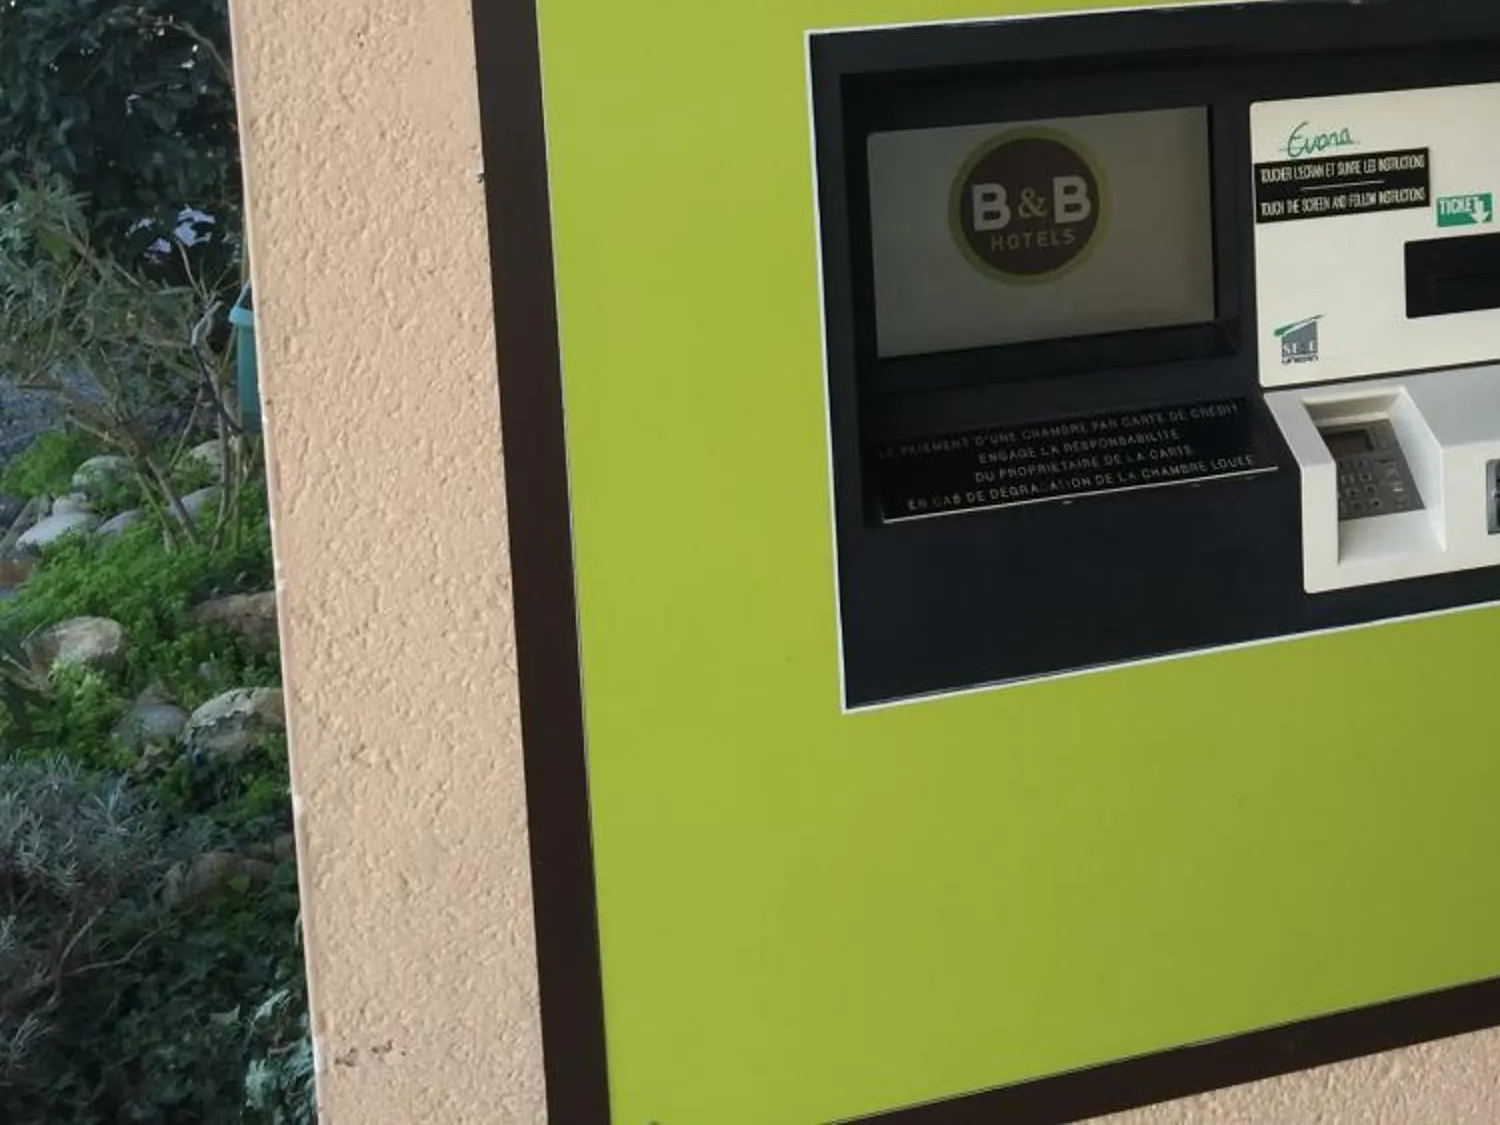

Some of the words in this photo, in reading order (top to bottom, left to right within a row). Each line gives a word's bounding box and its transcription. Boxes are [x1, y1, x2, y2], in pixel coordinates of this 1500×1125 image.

[1260, 166, 1293, 183] TOUCHER
[1326, 162, 1336, 177] ET
[1337, 159, 1363, 177] SUIVRE
[1364, 158, 1377, 174] LES
[1378, 154, 1425, 172] INSTRUCTIONS
[971, 174, 1093, 232] B&B
[1260, 200, 1285, 217] TOUCH
[1287, 199, 1301, 215] THE
[1302, 196, 1331, 213] SCREEN
[1332, 194, 1347, 211] AND
[1348, 191, 1377, 209] FOLLOW
[1378, 186, 1425, 205] INSTRUCTIONS
[1439, 196, 1480, 215] TICKET
[990, 228, 1077, 252] HOTELS
